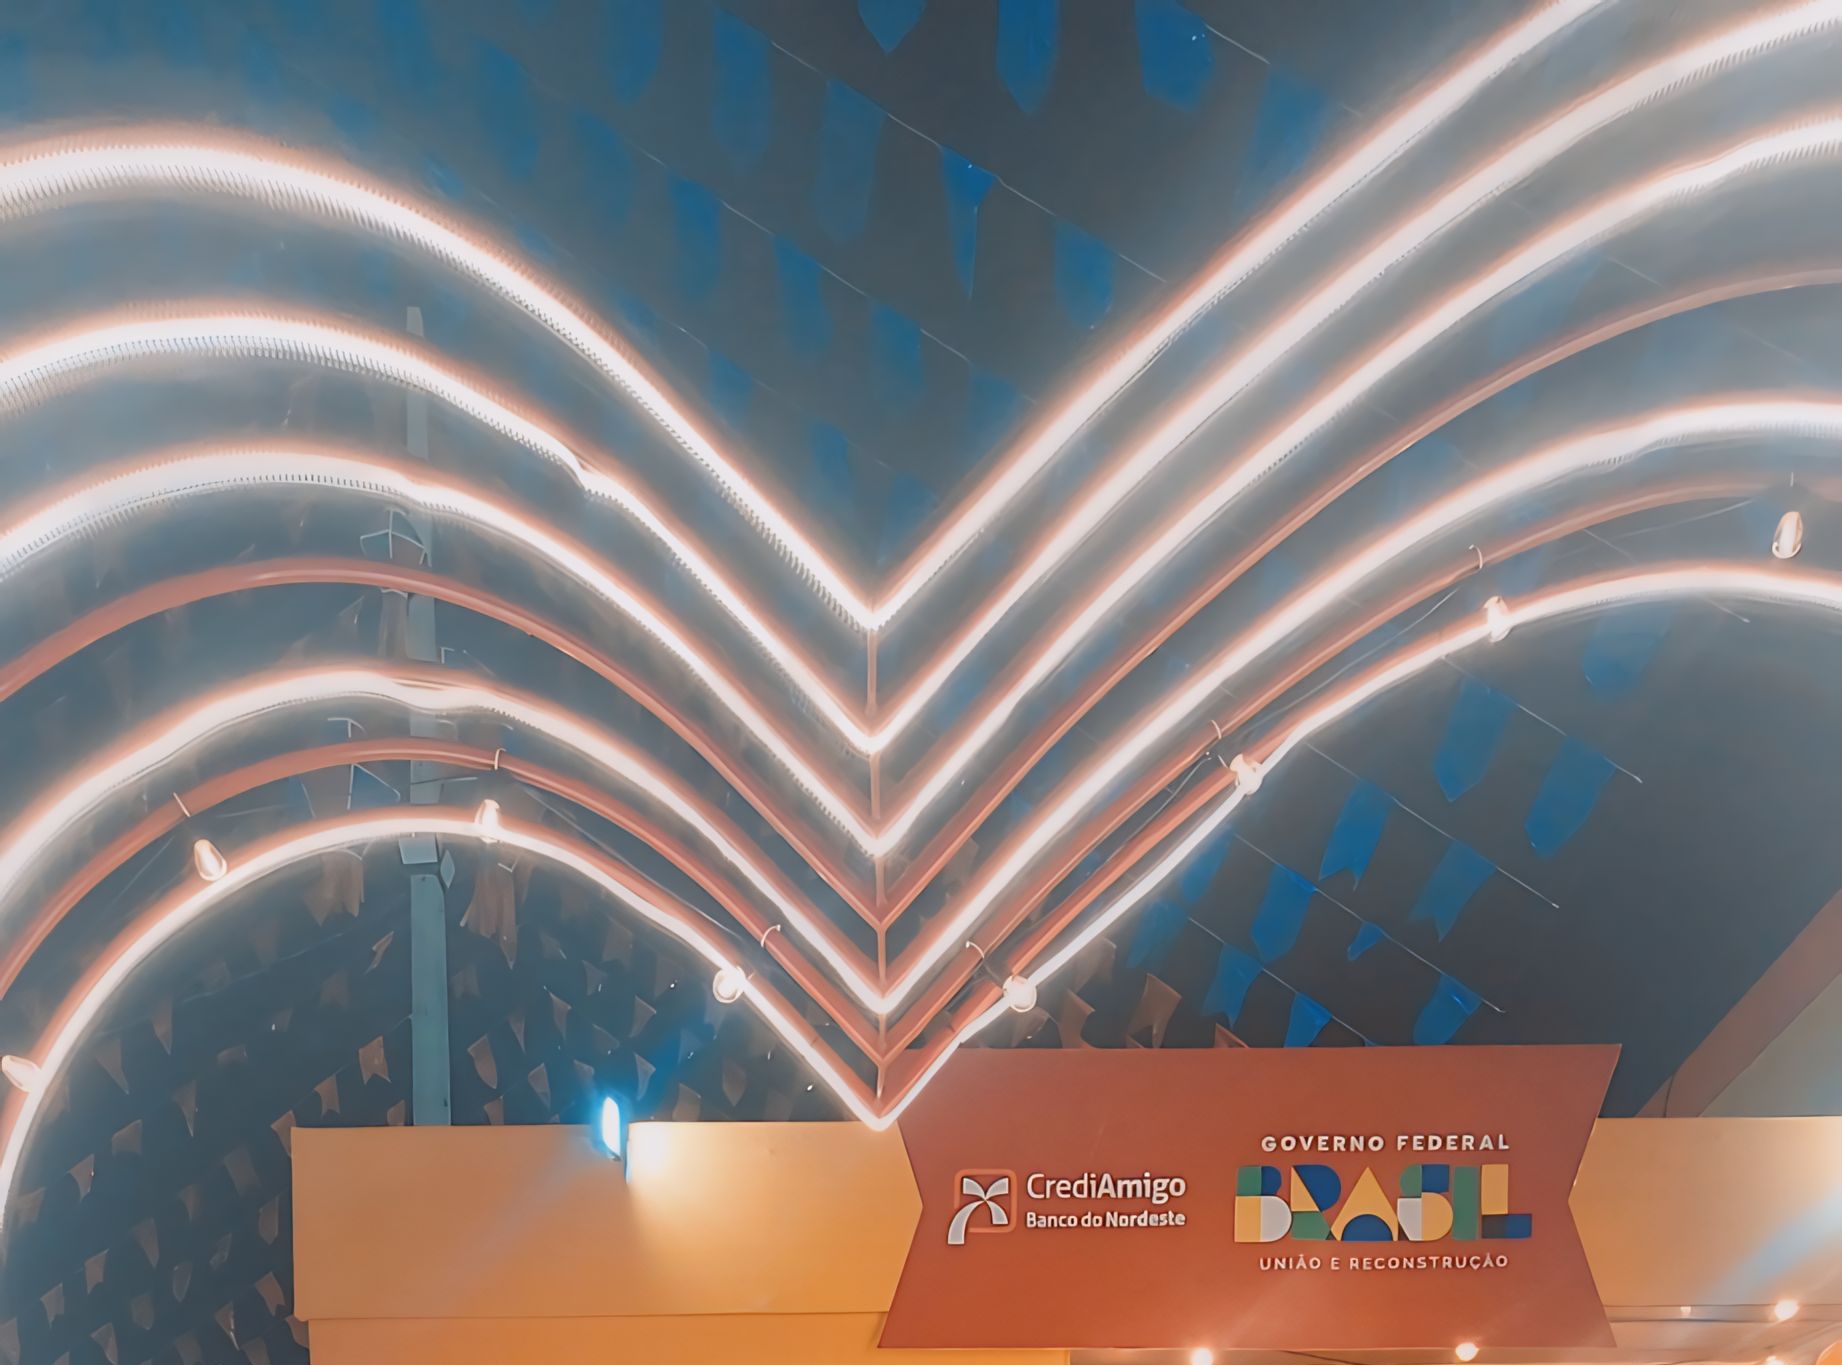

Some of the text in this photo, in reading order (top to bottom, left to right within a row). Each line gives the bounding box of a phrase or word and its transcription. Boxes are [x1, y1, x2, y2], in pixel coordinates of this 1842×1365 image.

[1261, 1134, 1510, 1152] GOVERNO FEDERAL
[1026, 1172, 1186, 1205] CrediAmigo
[1234, 1164, 1533, 1243] BRASIL
[1026, 1210, 1186, 1228] Banco do Nordeste
[1259, 1254, 1508, 1271] UNIÃO E RECONSTRUÇÃO
